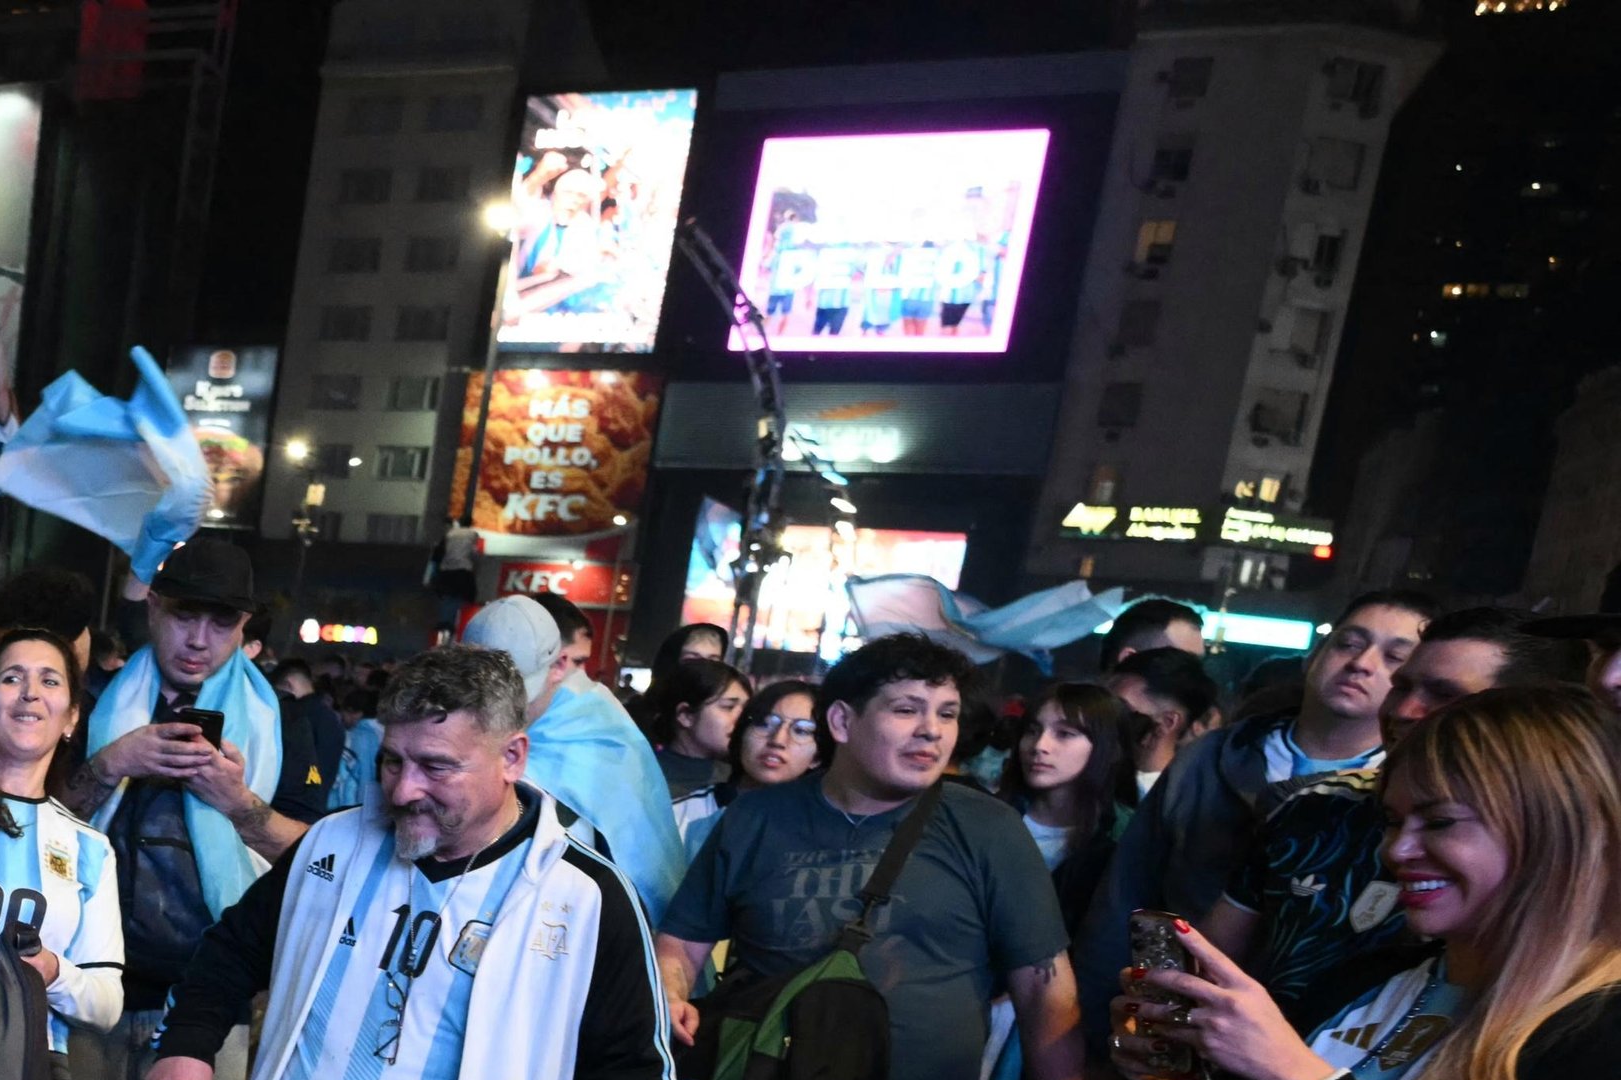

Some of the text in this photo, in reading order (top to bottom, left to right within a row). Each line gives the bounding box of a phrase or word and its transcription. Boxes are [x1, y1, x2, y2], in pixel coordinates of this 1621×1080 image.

[527, 394, 590, 419] MÁS
[525, 422, 584, 446] QUE
[502, 446, 599, 469] POLLO,
[529, 470, 563, 489] ES
[502, 492, 588, 522] KFC
[503, 570, 574, 596] KFC
[306, 865, 335, 883] adidas
[378, 903, 443, 979] 10
